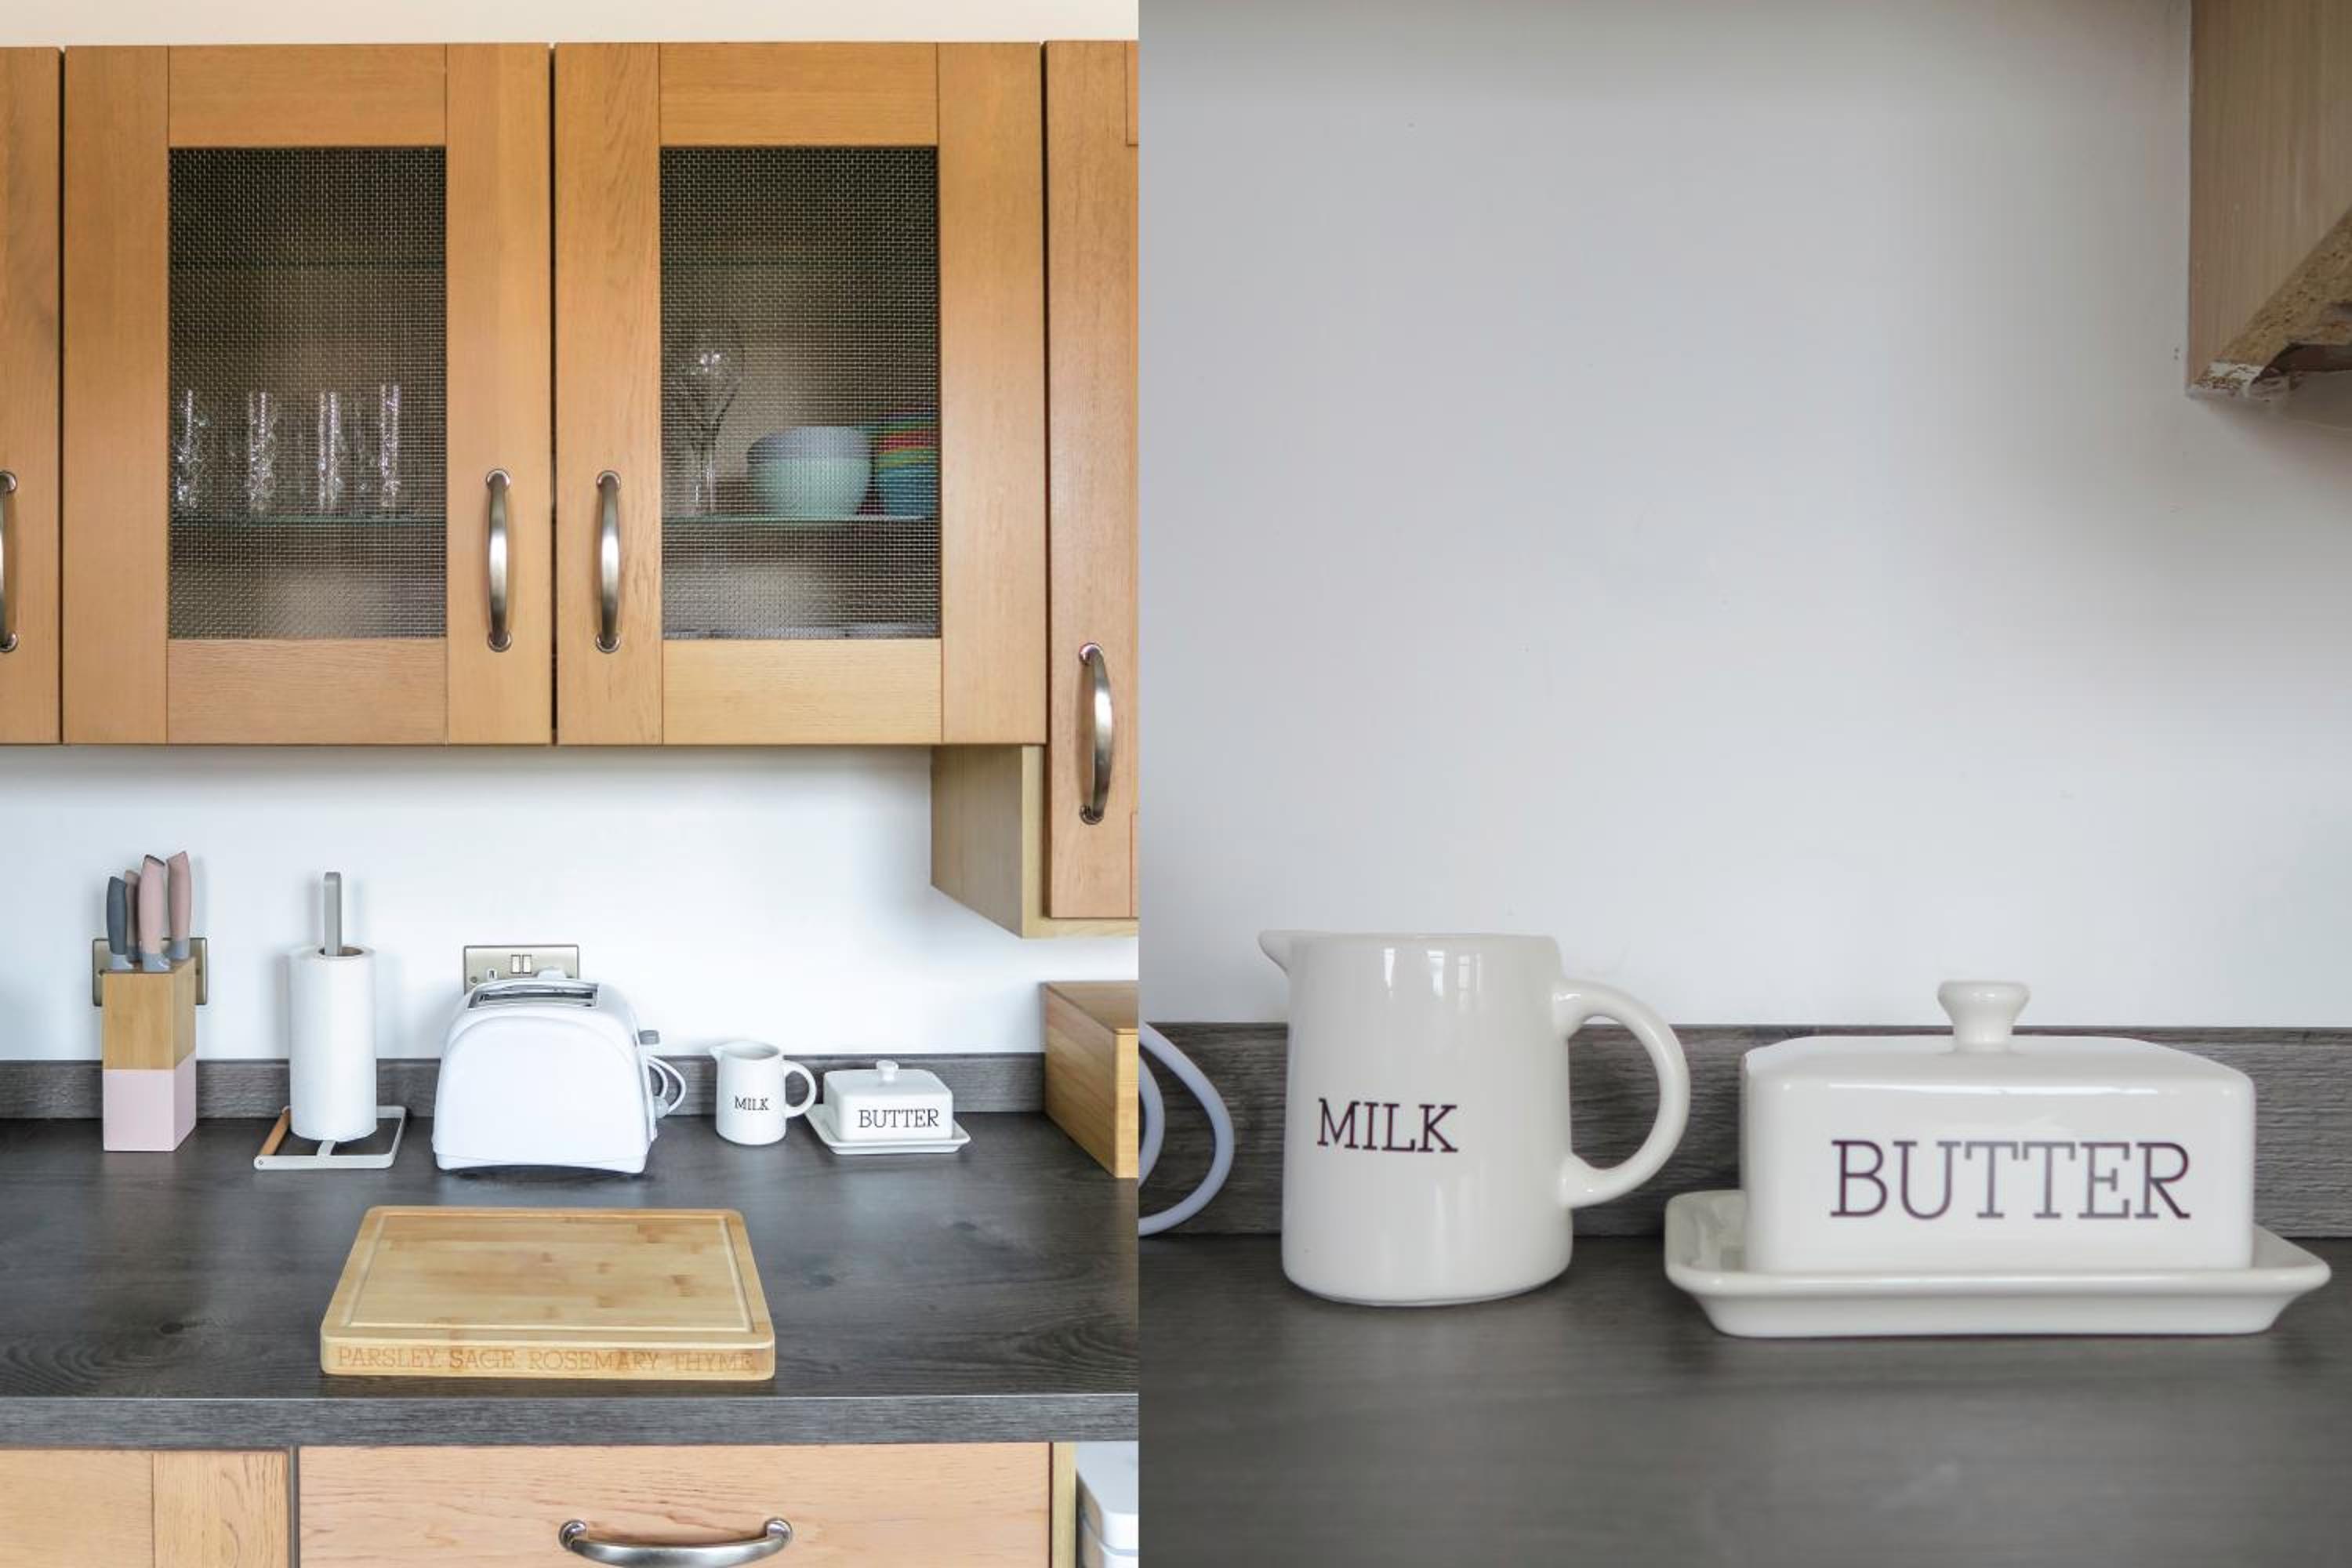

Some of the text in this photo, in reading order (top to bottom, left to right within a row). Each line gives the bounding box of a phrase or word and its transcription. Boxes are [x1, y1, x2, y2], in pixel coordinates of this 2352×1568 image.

[735, 1096, 770, 1111] MILK
[858, 1108, 939, 1128] BUTTER
[1317, 1098, 1458, 1152] MILK
[1830, 1140, 2190, 1219] BUTTER
[449, 1348, 515, 1369] SAGE
[528, 1350, 659, 1370] ROSEMARY
[673, 1352, 754, 1371] THYME
